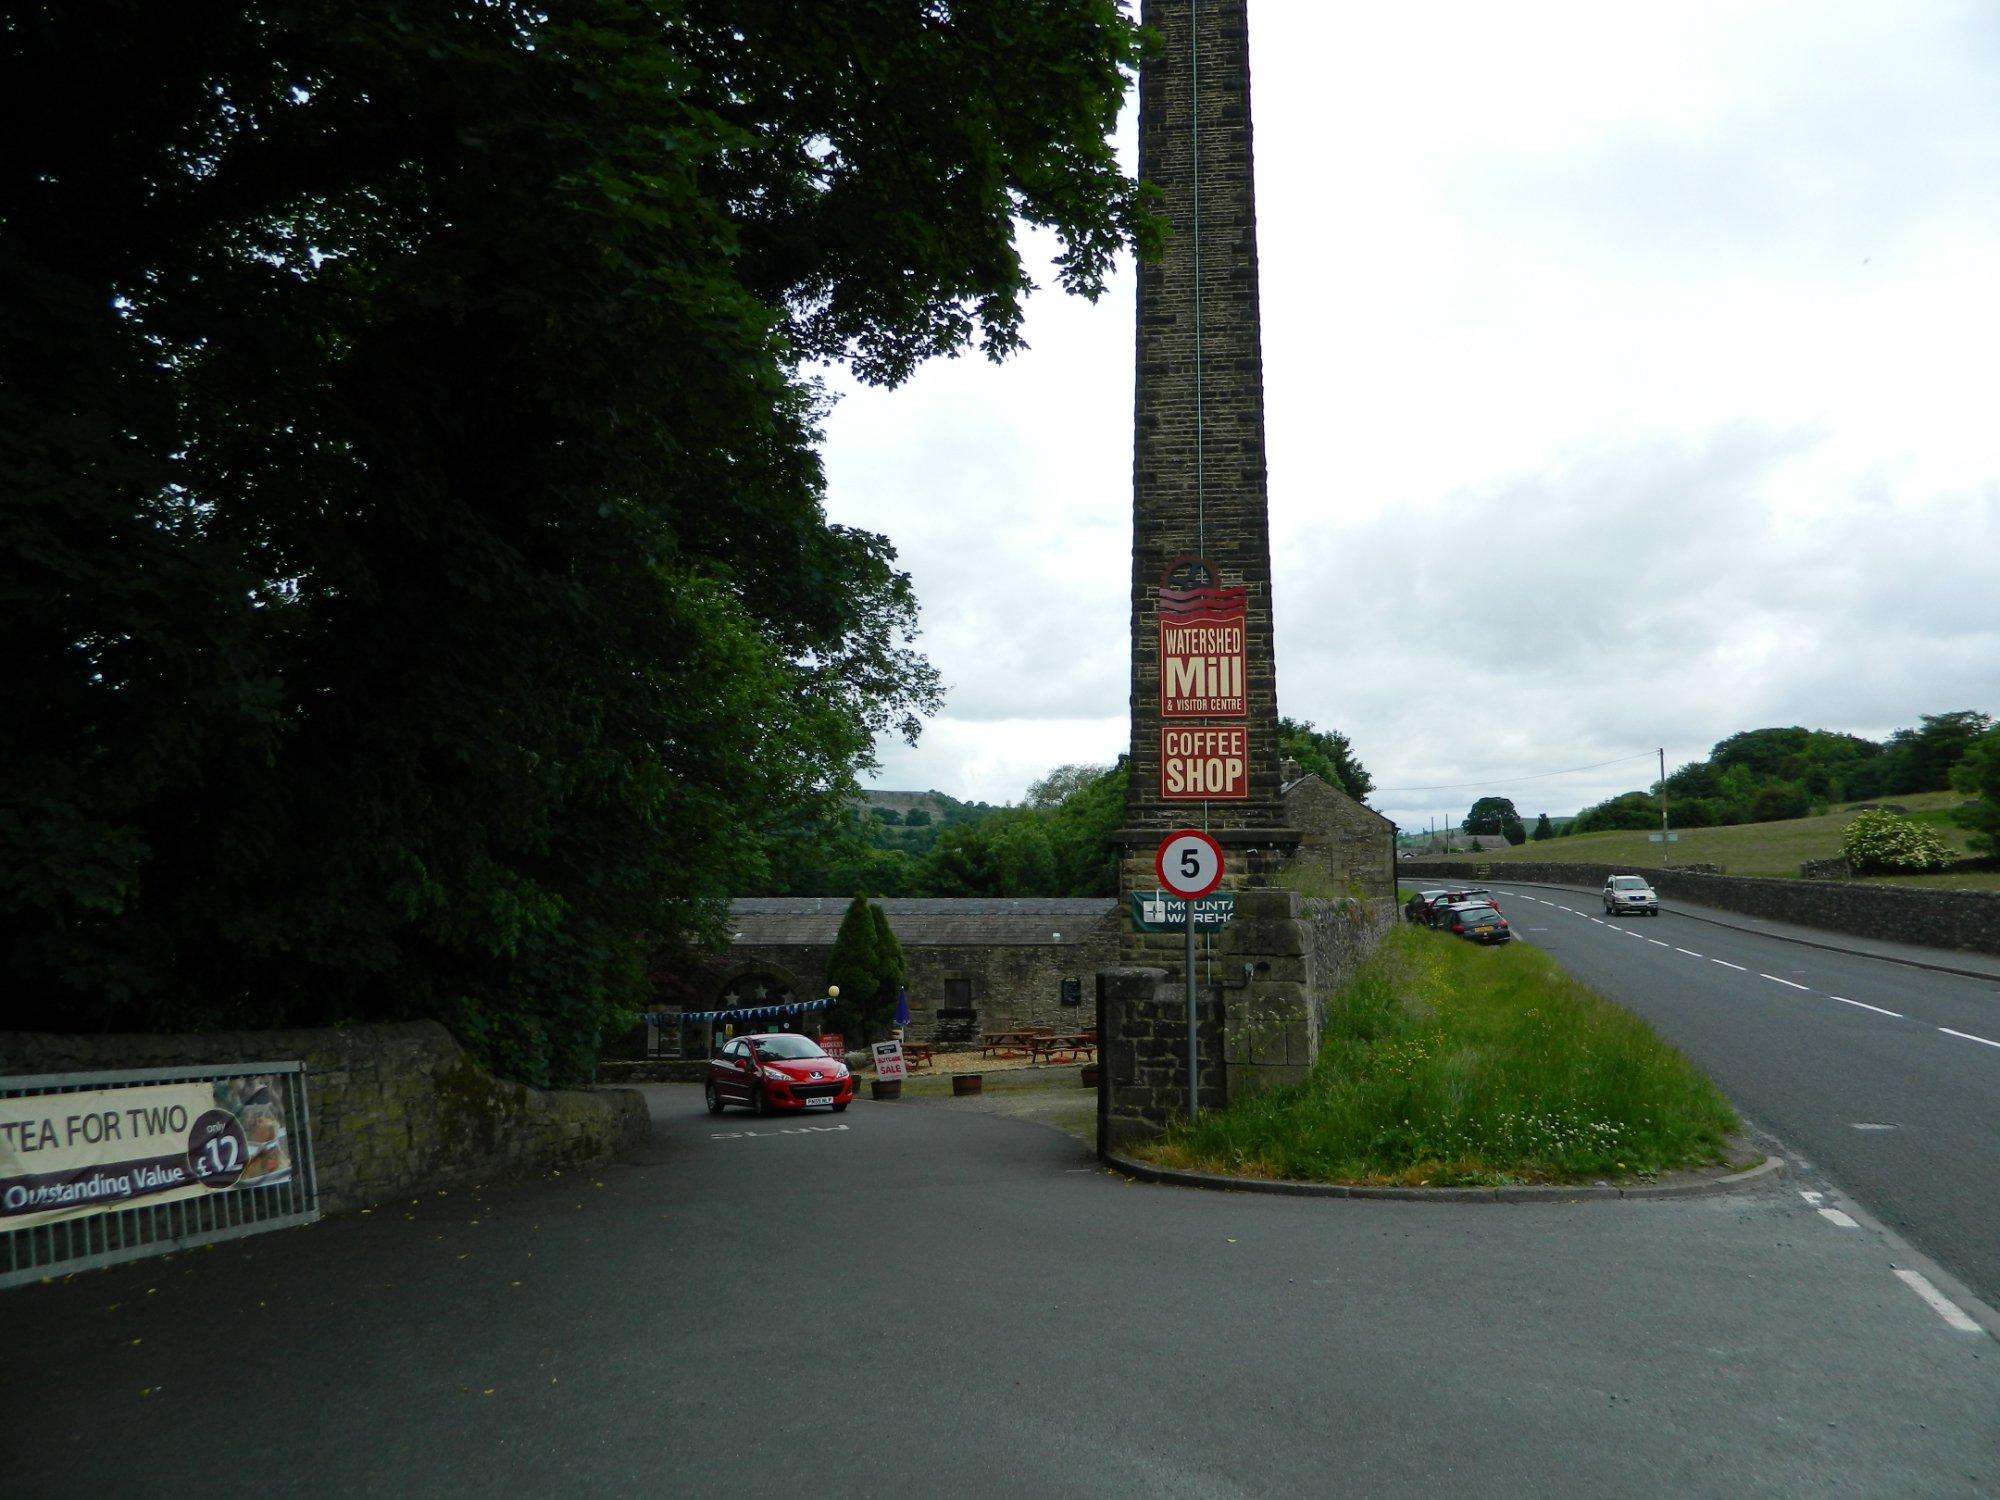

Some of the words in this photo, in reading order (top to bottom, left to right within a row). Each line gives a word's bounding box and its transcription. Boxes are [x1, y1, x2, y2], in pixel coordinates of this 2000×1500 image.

[1166, 628, 1241, 654] WATERSHED
[1166, 656, 1242, 698] Mill
[1167, 699, 1173, 711] &
[1176, 699, 1208, 711] VISITOR
[1210, 699, 1242, 711] CENTRE
[1166, 732, 1242, 756] COFFEE
[1166, 757, 1243, 793] SHOP
[1180, 848, 1200, 878] 5
[879, 1065, 902, 1074] SALE
[1, 1119, 59, 1152] TEA
[67, 1111, 121, 1146] FOR
[126, 1104, 188, 1138] TWO
[206, 1121, 226, 1134] only
[197, 1135, 244, 1178] £12
[4, 1173, 131, 1208] Outstanding
[133, 1164, 184, 1189] Value
